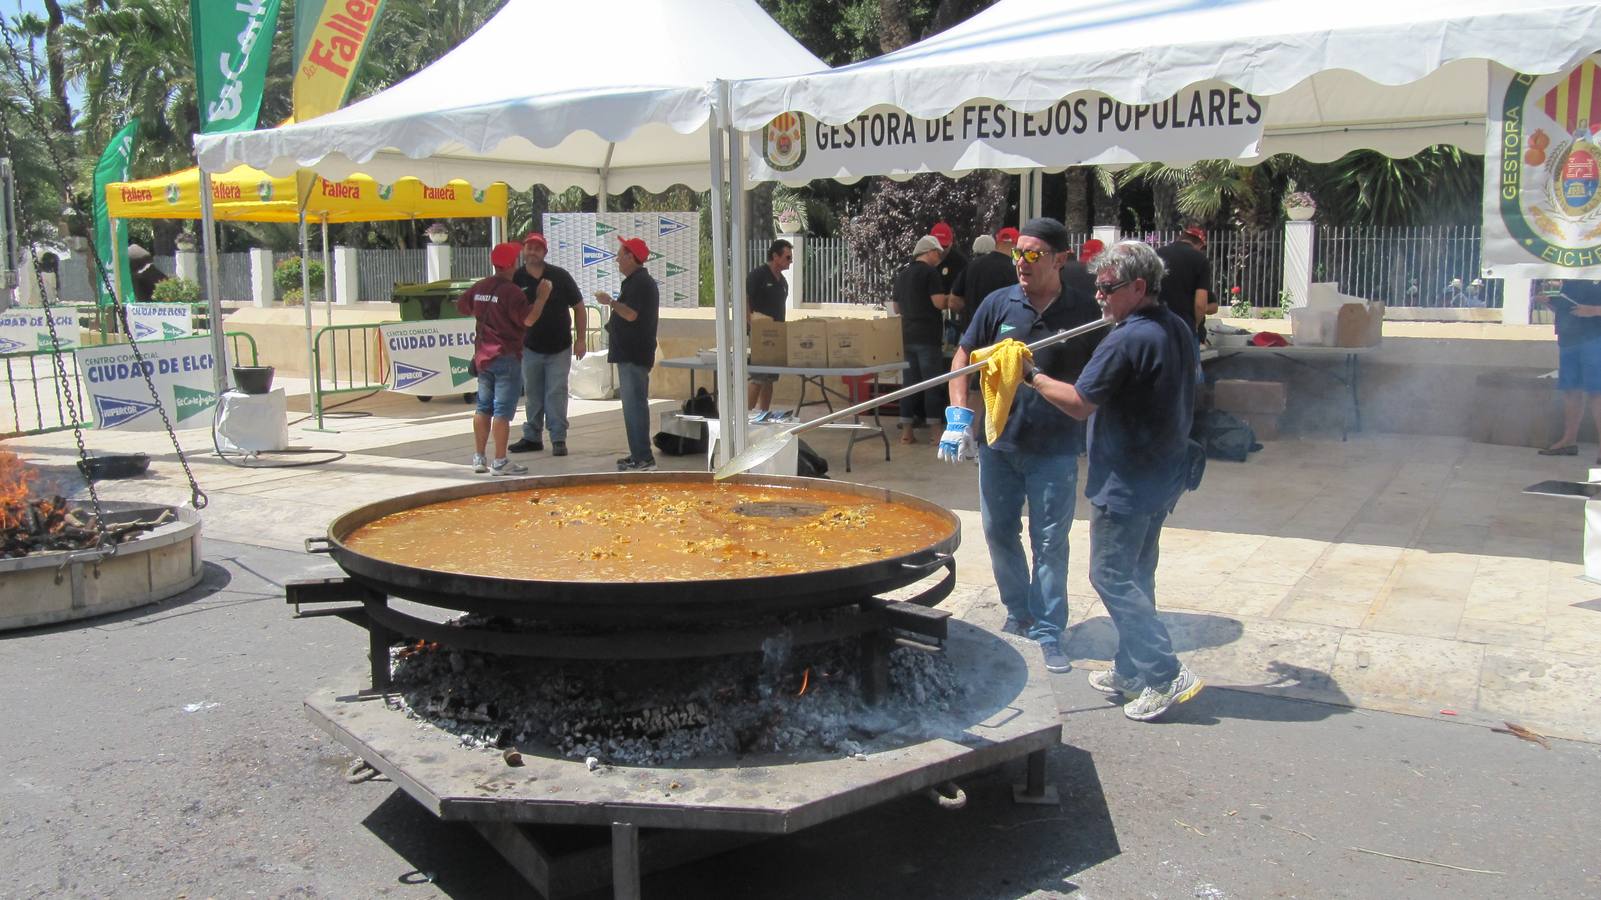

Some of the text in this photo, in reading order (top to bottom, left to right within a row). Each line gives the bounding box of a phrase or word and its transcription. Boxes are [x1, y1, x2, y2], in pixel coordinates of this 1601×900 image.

[308, 0, 378, 79] Falle
[816, 88, 1262, 151] GESTORA DE FESTEJOS POPULARES
[1502, 105, 1520, 200] GESTORA
[30, 316, 44, 327] DE
[389, 332, 475, 351] CIUDAD DE ELC
[84, 356, 116, 366] CENTRO
[87, 360, 155, 384] CIUDAD
[158, 358, 179, 375] DE
[103, 405, 137, 418] HIPERCOR
